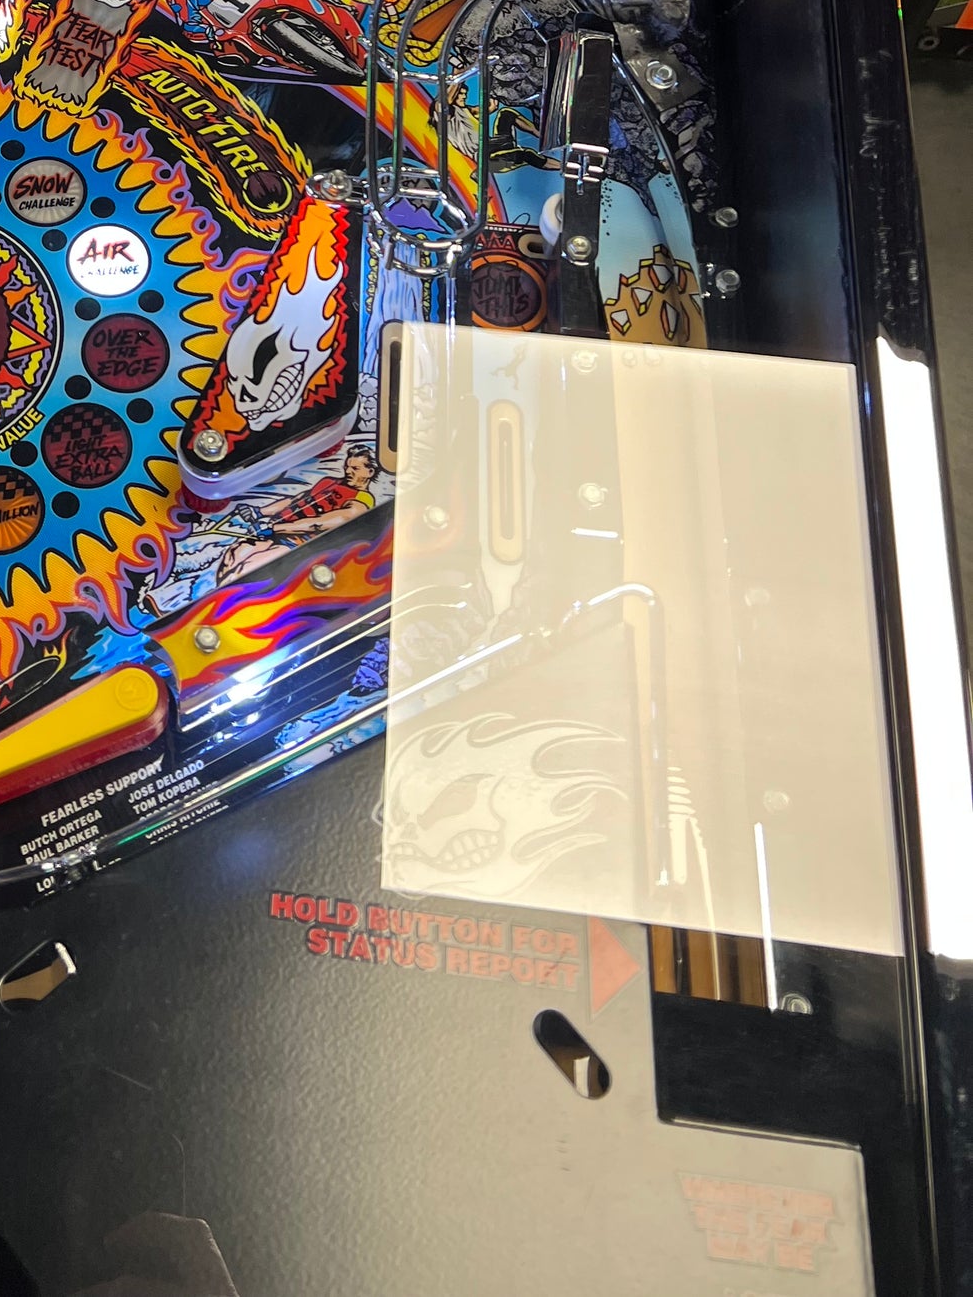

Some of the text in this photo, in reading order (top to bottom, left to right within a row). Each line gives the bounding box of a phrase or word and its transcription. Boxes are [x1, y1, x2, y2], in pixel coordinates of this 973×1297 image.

[68, 12, 117, 53] FEAR
[51, 40, 105, 78] FEST
[13, 172, 74, 200] SNOW
[18, 197, 76, 211] CHALLENGE
[77, 238, 135, 265] AIR
[92, 328, 155, 347] OVER
[104, 346, 139, 359] THE
[97, 356, 160, 377] EDGE
[55, 447, 124, 470] EXTRA
[64, 435, 108, 453] LIGHT
[68, 459, 115, 483] BALL
[41, 789, 105, 827] FEARLESS
[105, 758, 163, 797] SUPPORT
[128, 783, 155, 804] JOSE
[156, 760, 205, 790] DELGADO
[132, 797, 157, 815] TOM
[158, 776, 201, 803] KOPERA
[20, 832, 58, 856] BUTCH
[59, 810, 103, 837] ORTEGA
[26, 847, 55, 867] PAUL
[55, 825, 100, 853] BARKER
[269, 891, 580, 957] HOLD BUTTON FOR
[307, 927, 580, 990] STATUS REPORT
